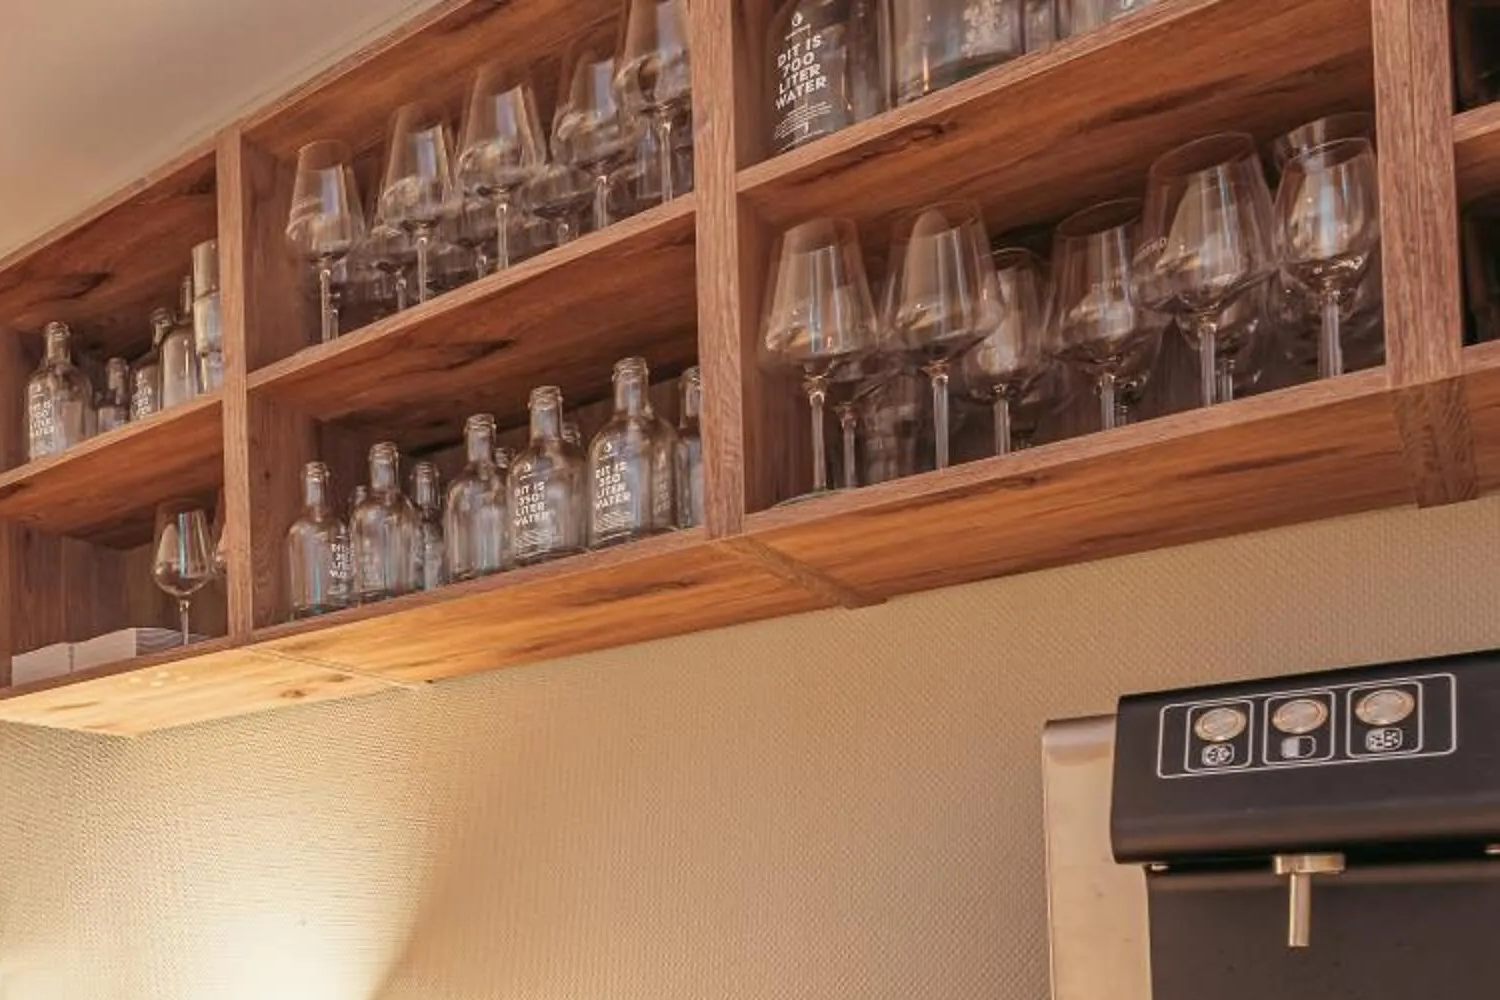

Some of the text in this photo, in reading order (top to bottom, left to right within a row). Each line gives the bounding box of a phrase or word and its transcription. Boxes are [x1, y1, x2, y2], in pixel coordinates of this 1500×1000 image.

[778, 34, 822, 68] DIT IS
[784, 51, 815, 78] 700
[776, 75, 828, 110] WATER
[780, 63, 821, 94] LITER
